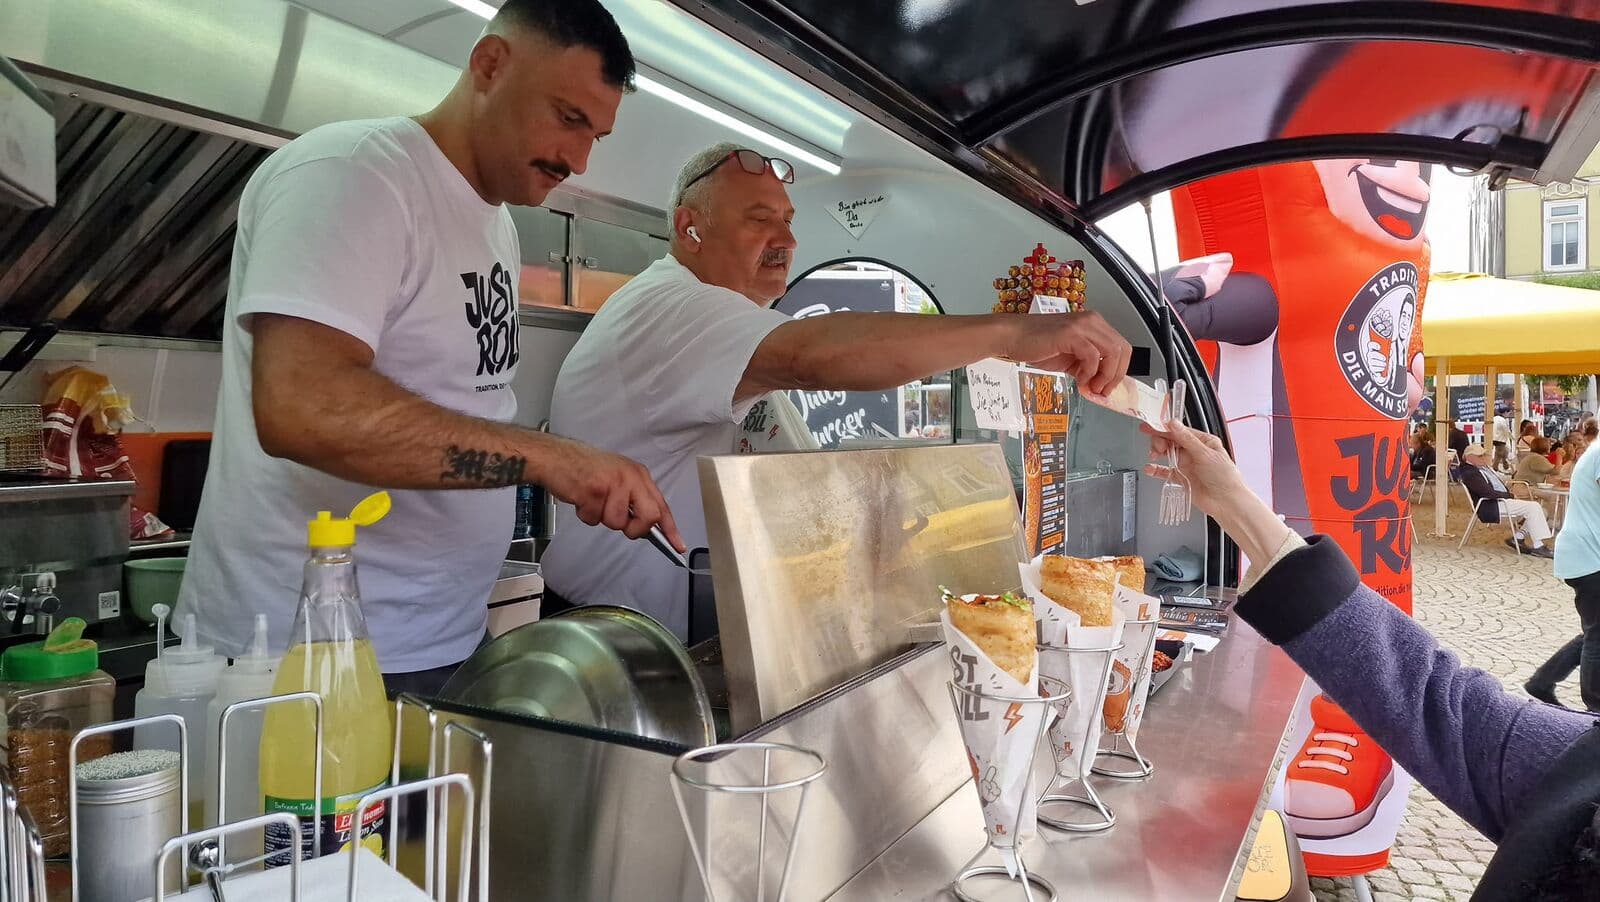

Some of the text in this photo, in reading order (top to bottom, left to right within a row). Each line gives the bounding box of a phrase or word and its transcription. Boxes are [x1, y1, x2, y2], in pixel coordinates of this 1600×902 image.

[460, 261, 514, 328] JUST
[1369, 267, 1417, 297] TRADITI
[1342, 351, 1365, 381] DIE
[1362, 381, 1394, 411] MAN
[811, 408, 865, 448] urger
